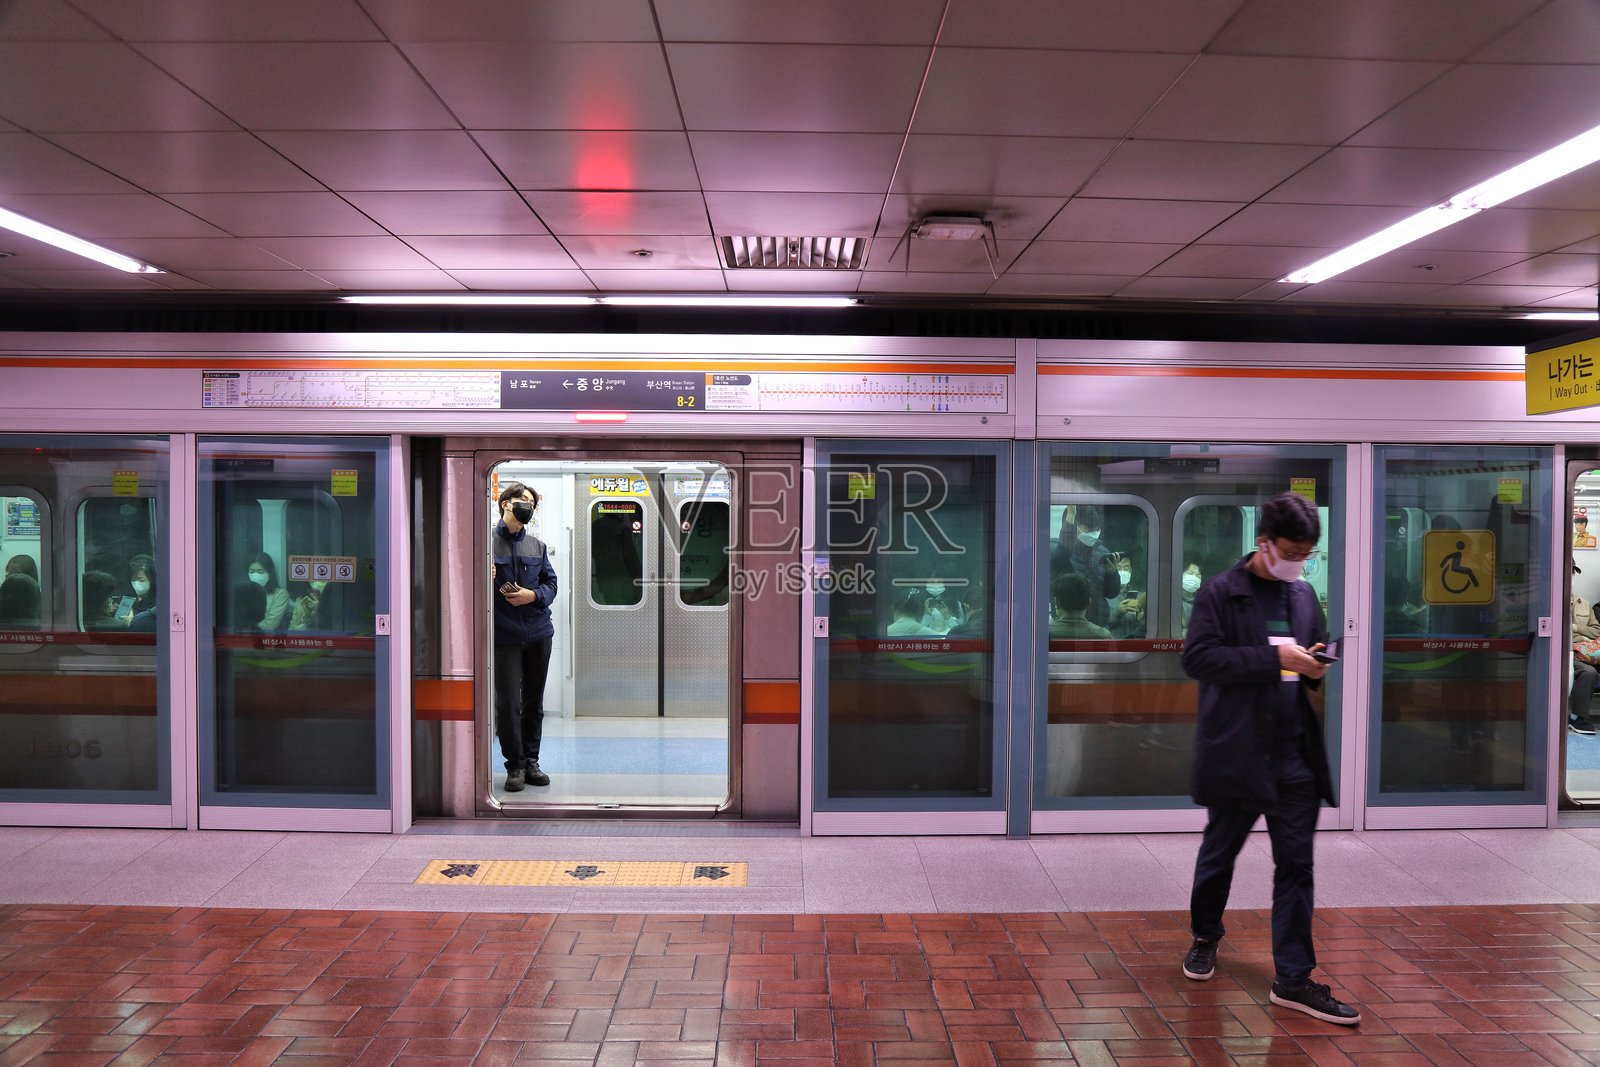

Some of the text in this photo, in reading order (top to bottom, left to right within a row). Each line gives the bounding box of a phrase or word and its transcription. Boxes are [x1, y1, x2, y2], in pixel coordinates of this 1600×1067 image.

[1548, 353, 1594, 383] 나가는
[605, 378, 626, 386] Jungang
[646, 380, 671, 390] 부산역
[1555, 386, 1573, 399] Way
[1573, 383, 1588, 395] Out
[677, 396, 695, 407] 8-2
[290, 639, 322, 647] 사용하는
